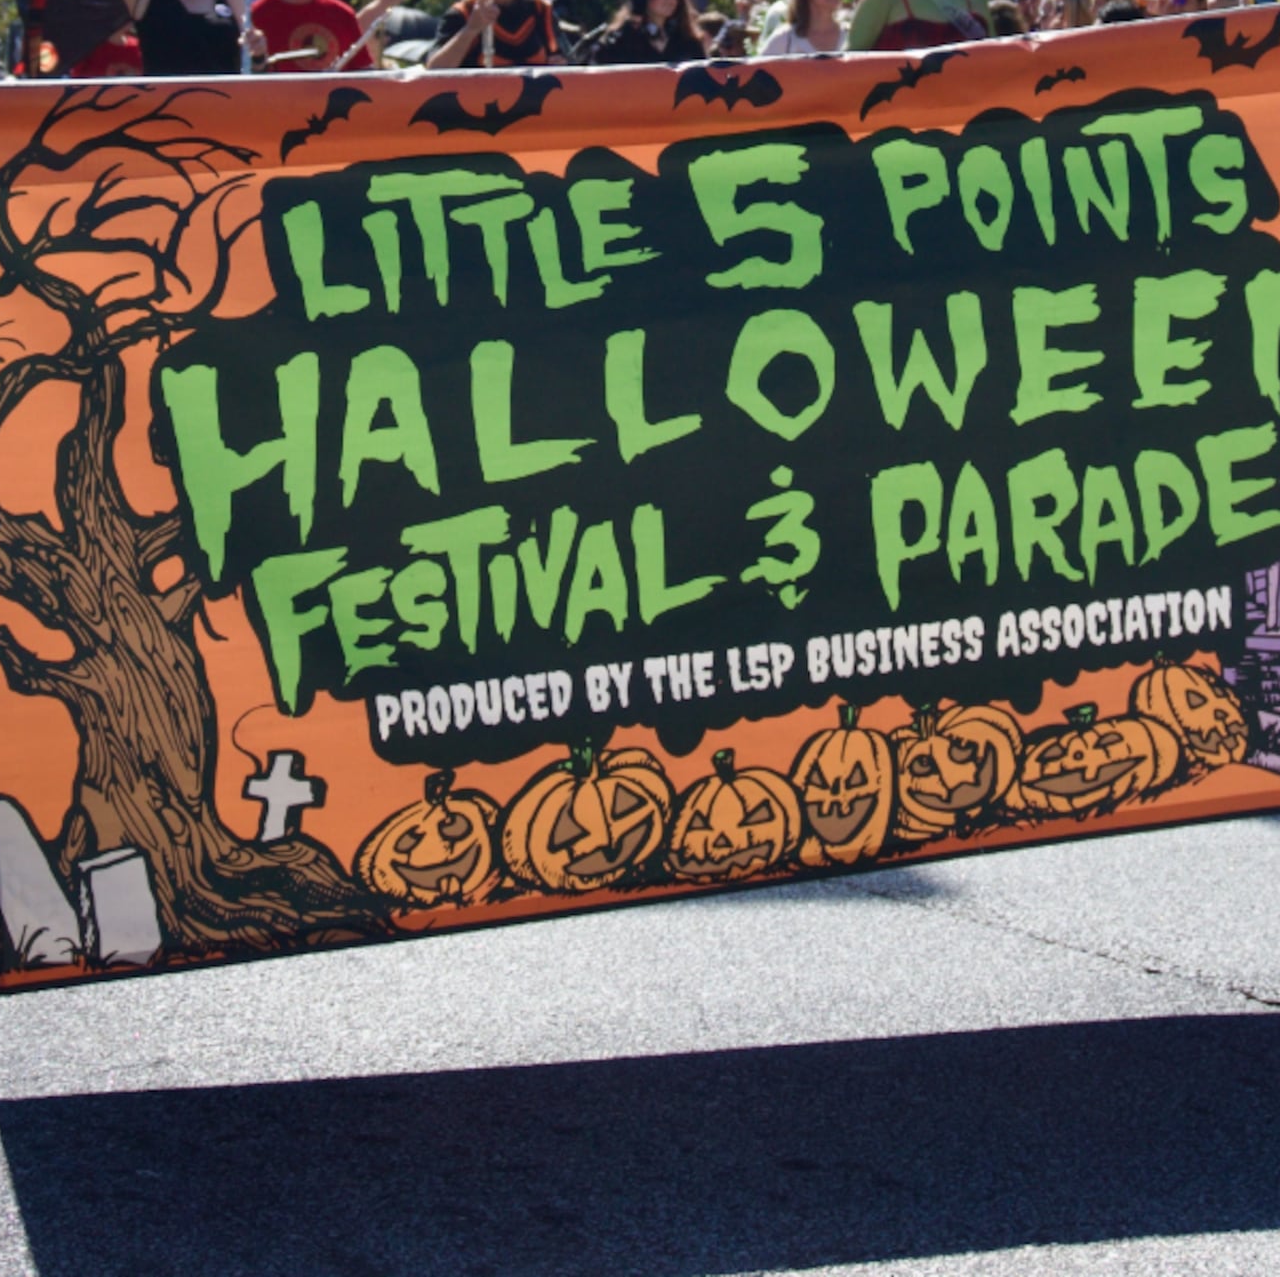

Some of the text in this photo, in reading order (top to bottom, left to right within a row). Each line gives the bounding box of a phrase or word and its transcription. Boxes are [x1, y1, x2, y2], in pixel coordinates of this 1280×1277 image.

[281, 105, 1249, 322] LITTLE 5 POINTS
[251, 504, 729, 714] FESTIVAL
[375, 669, 574, 742] PRODUCED
[584, 661, 634, 713] BY
[642, 650, 717, 704] THE
[806, 615, 986, 684] BUSINESS
[996, 584, 1234, 658] ASSOCIATION
